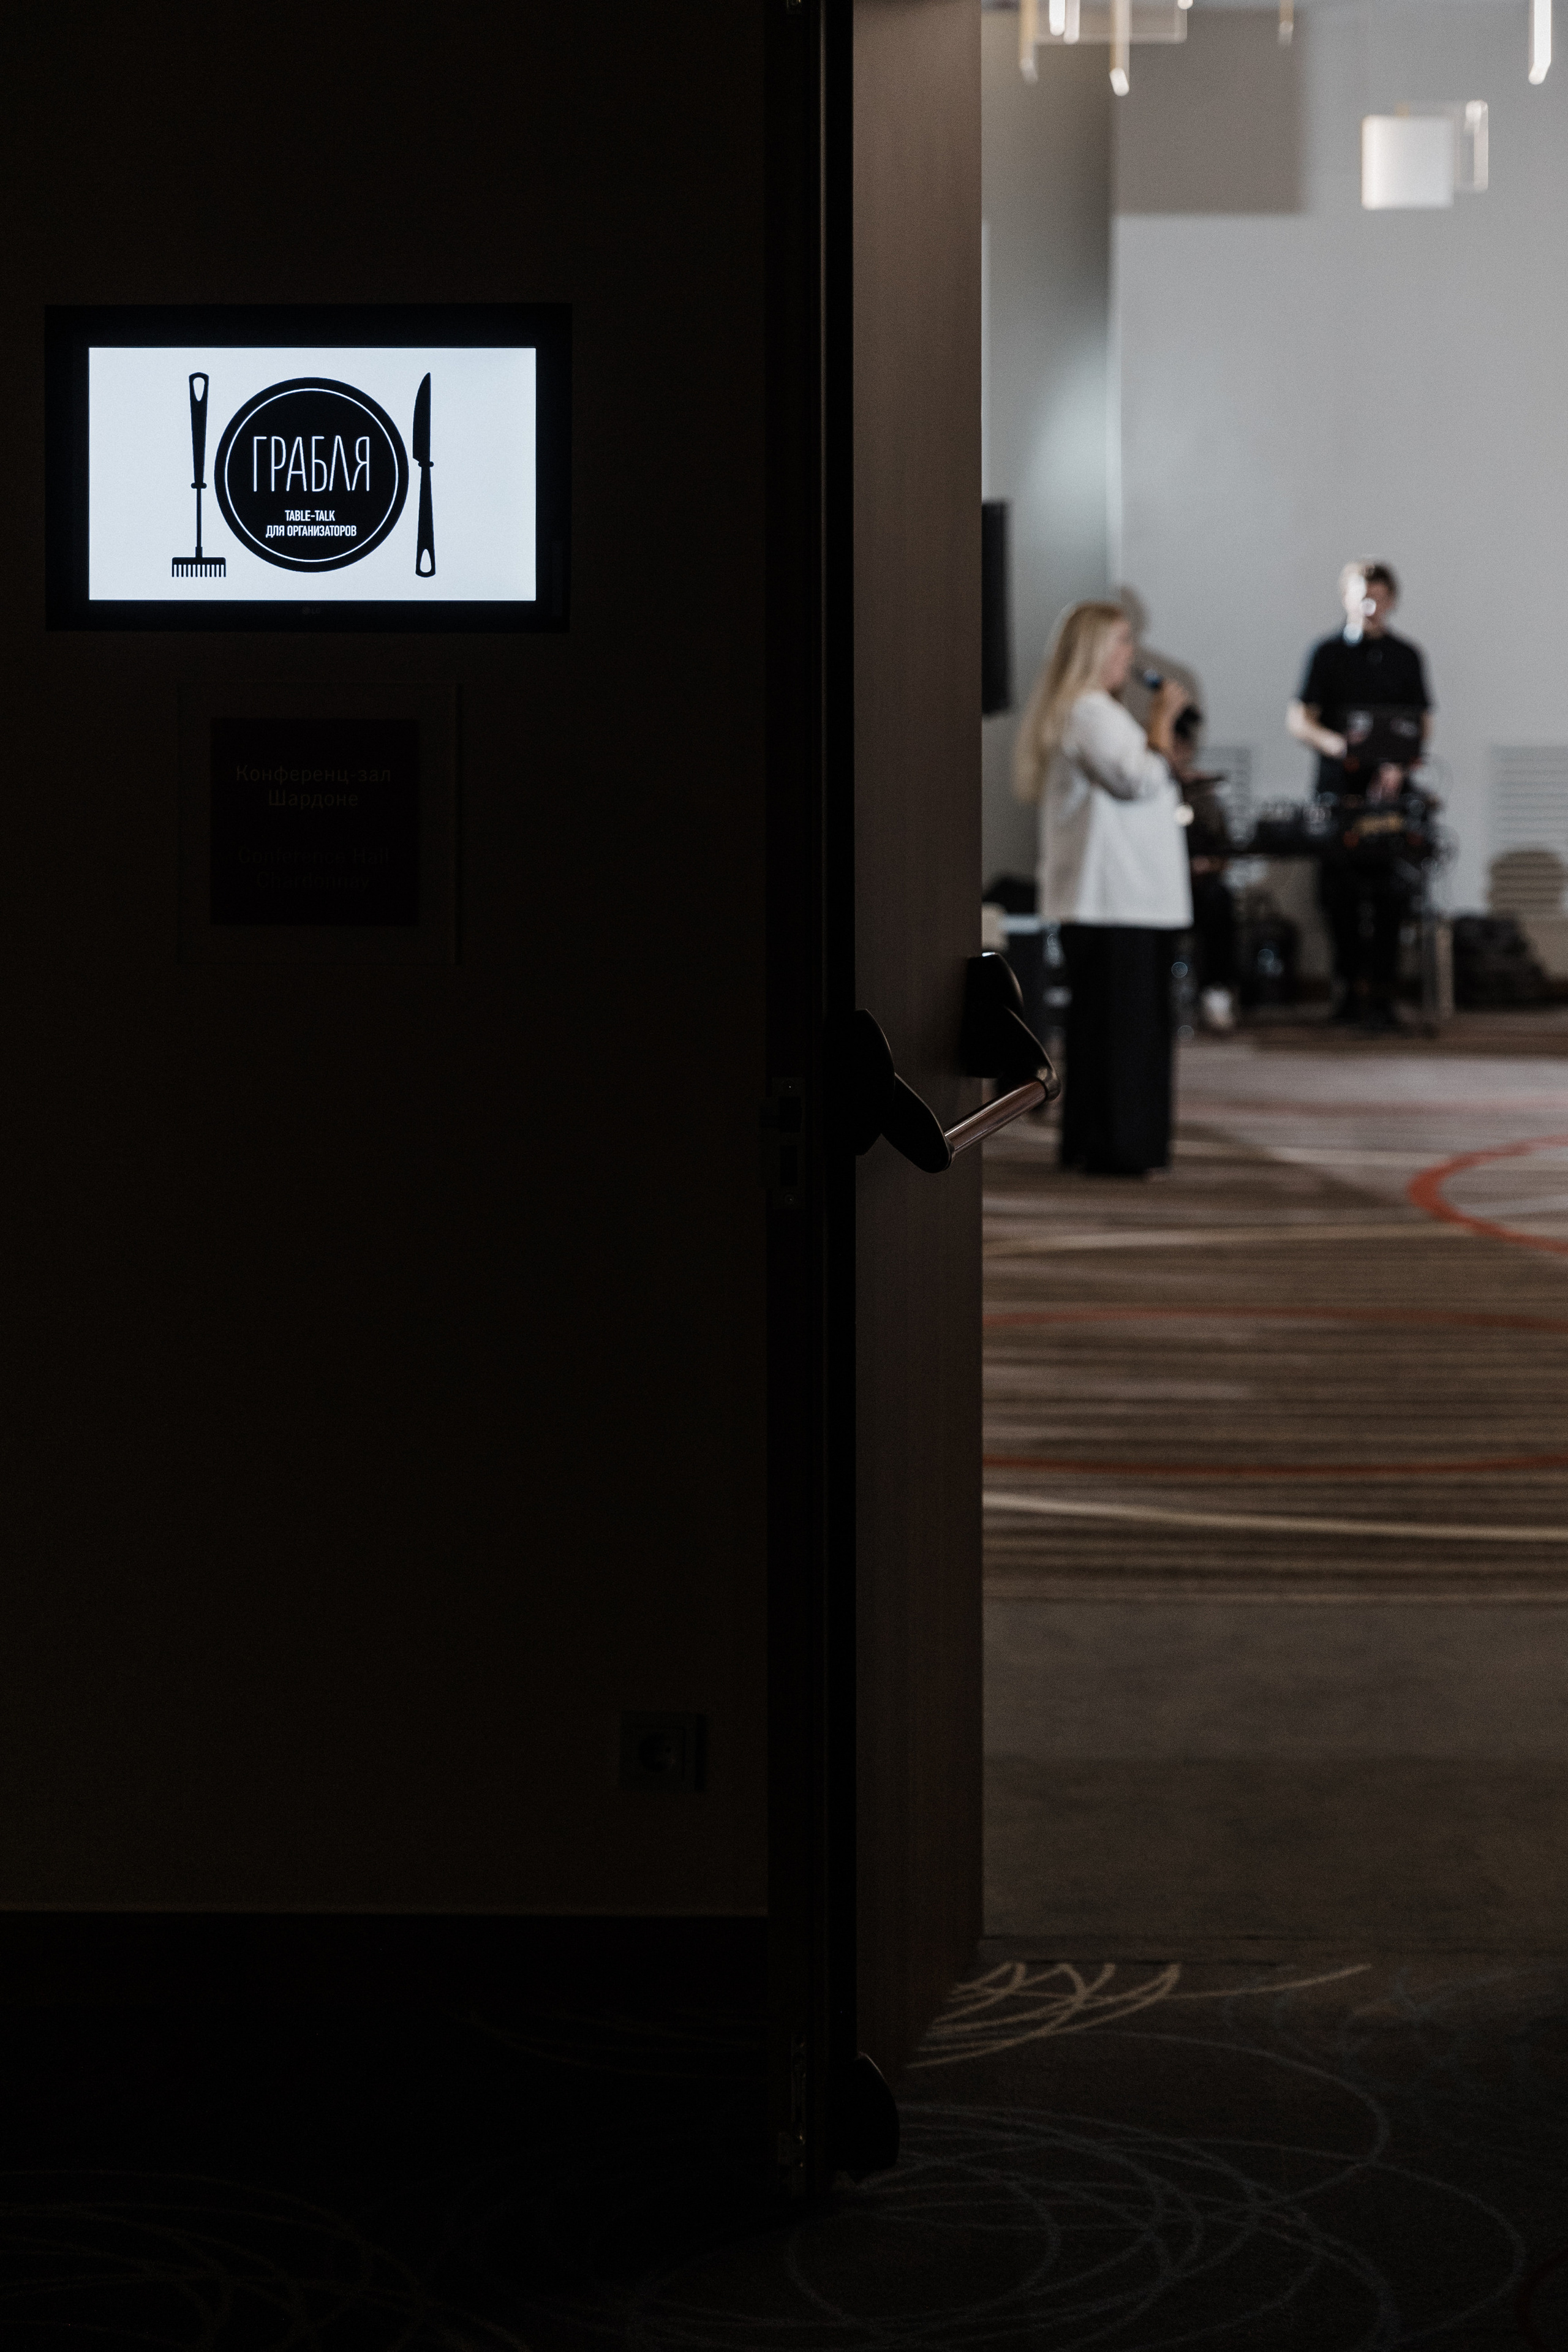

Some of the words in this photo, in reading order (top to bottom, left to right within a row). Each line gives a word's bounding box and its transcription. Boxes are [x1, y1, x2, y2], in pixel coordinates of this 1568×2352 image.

[253, 435, 370, 492] ГРАБЛЯ
[285, 510, 335, 521] TABLE-TALK
[265, 525, 285, 538] ДЛЯ
[287, 525, 357, 537] ОРГАНИЗАТОРОВ
[236, 765, 391, 785] Конференц-зал
[268, 790, 359, 809] Шардоне
